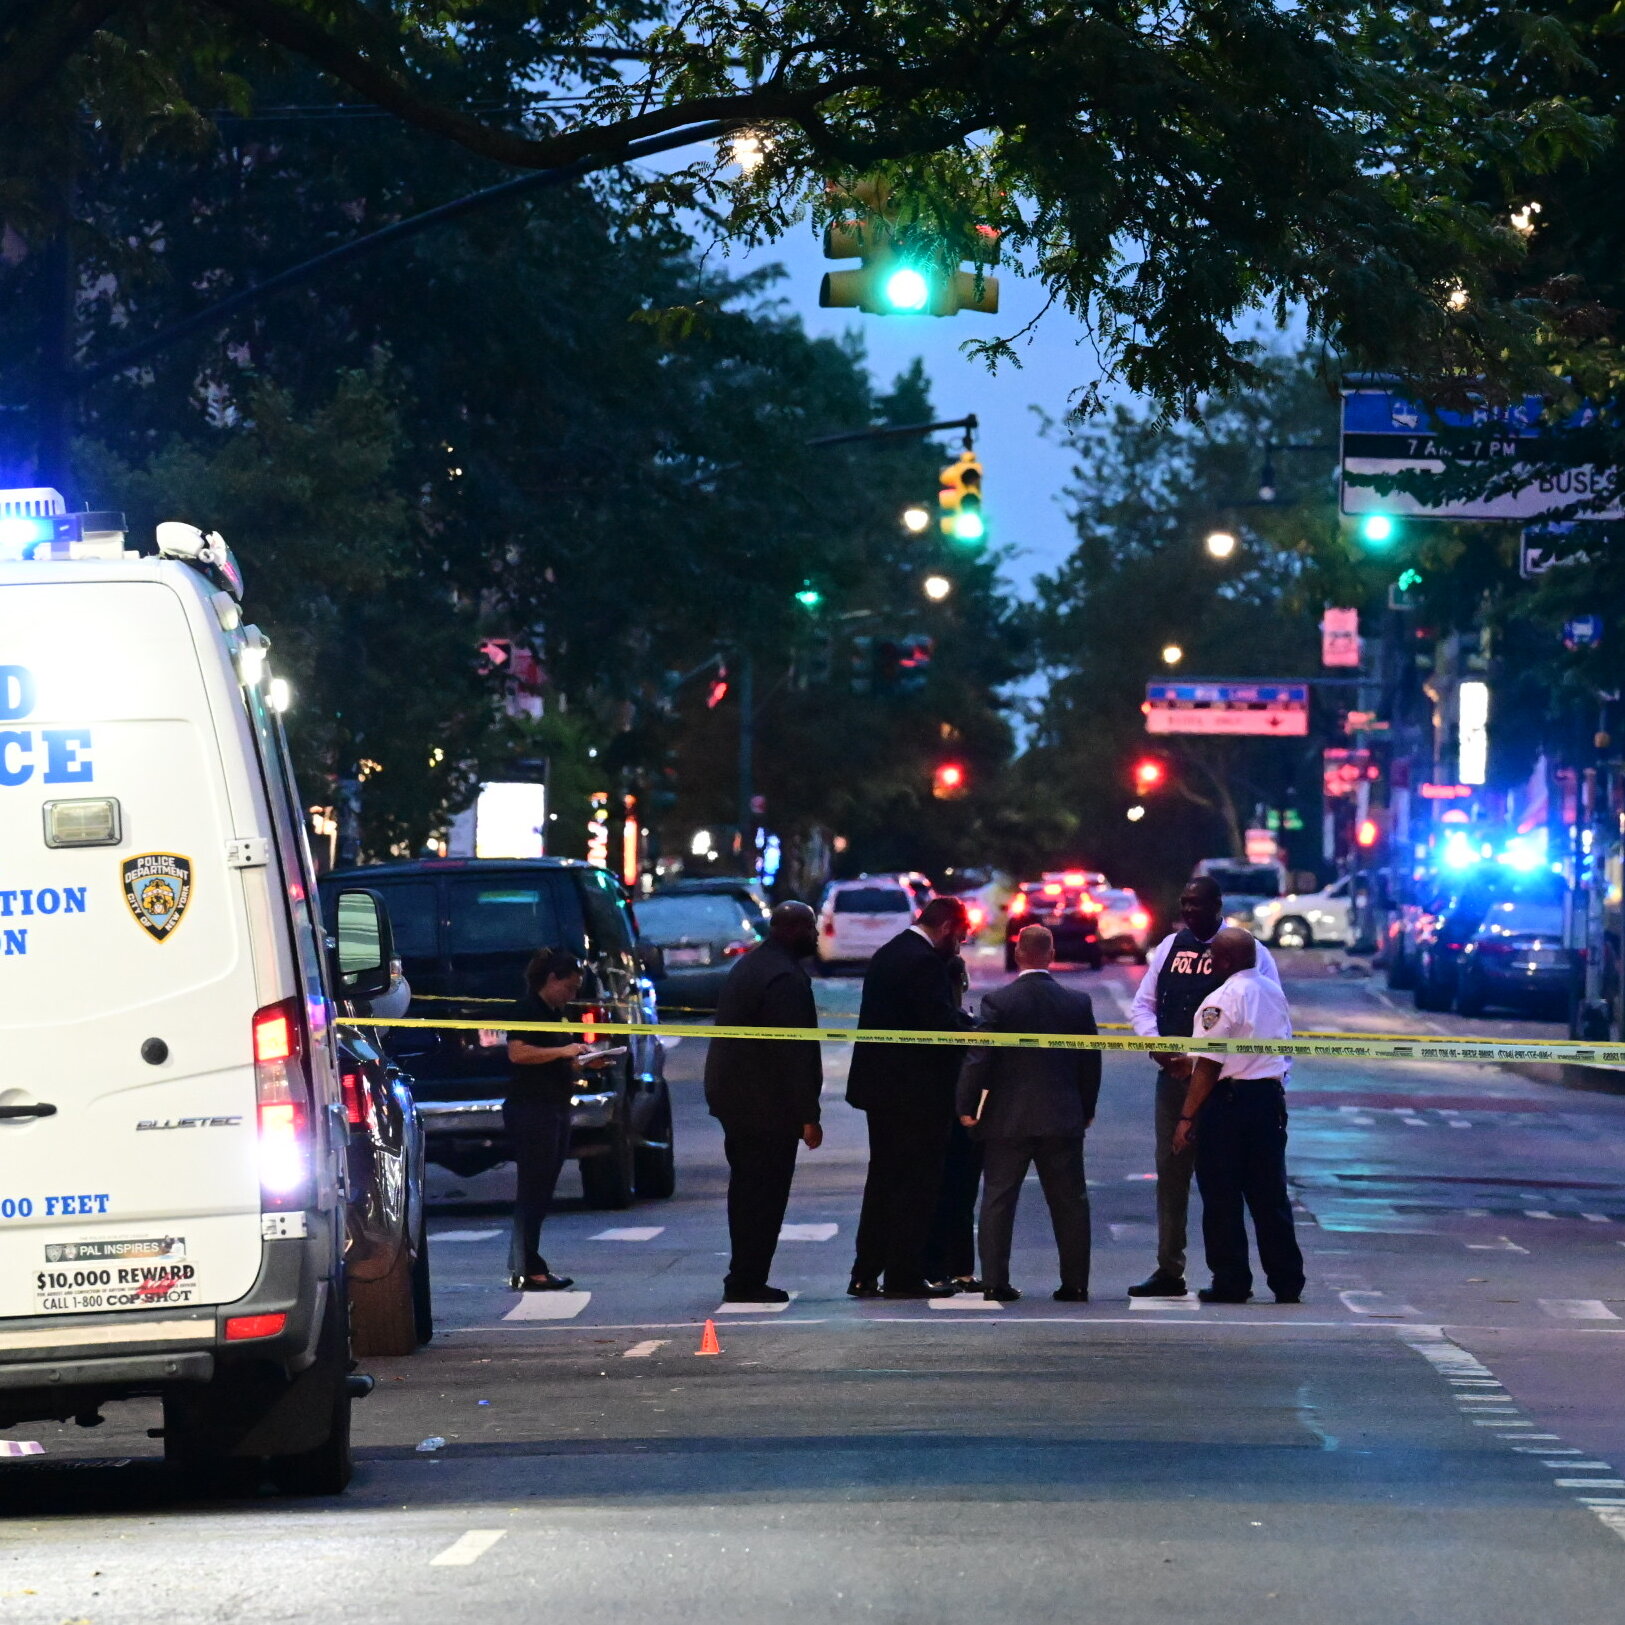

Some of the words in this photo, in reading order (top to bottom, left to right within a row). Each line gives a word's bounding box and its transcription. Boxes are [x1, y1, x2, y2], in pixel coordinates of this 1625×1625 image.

[1407, 439, 1418, 456] 7
[1471, 440, 1482, 457] 7
[1489, 441, 1516, 457] PM
[137, 856, 176, 868] POLICE
[124, 865, 188, 883] DEPARTMENT
[127, 893, 142, 914] CITY
[140, 916, 152, 927] OF
[164, 911, 180, 931] NEW
[177, 885, 190, 908] YORK
[0, 929, 28, 956] N
[1170, 957, 1212, 975] POLIC
[135, 1116, 243, 1131] BLUETEC
[45, 1194, 109, 1216] FEET
[79, 1244, 102, 1256] PAL
[104, 1242, 159, 1255] INSPIRES
[37, 1270, 111, 1291] $10,000
[118, 1264, 195, 1284] REWARD
[43, 1296, 69, 1310] CALL
[73, 1295, 103, 1308] 1-800
